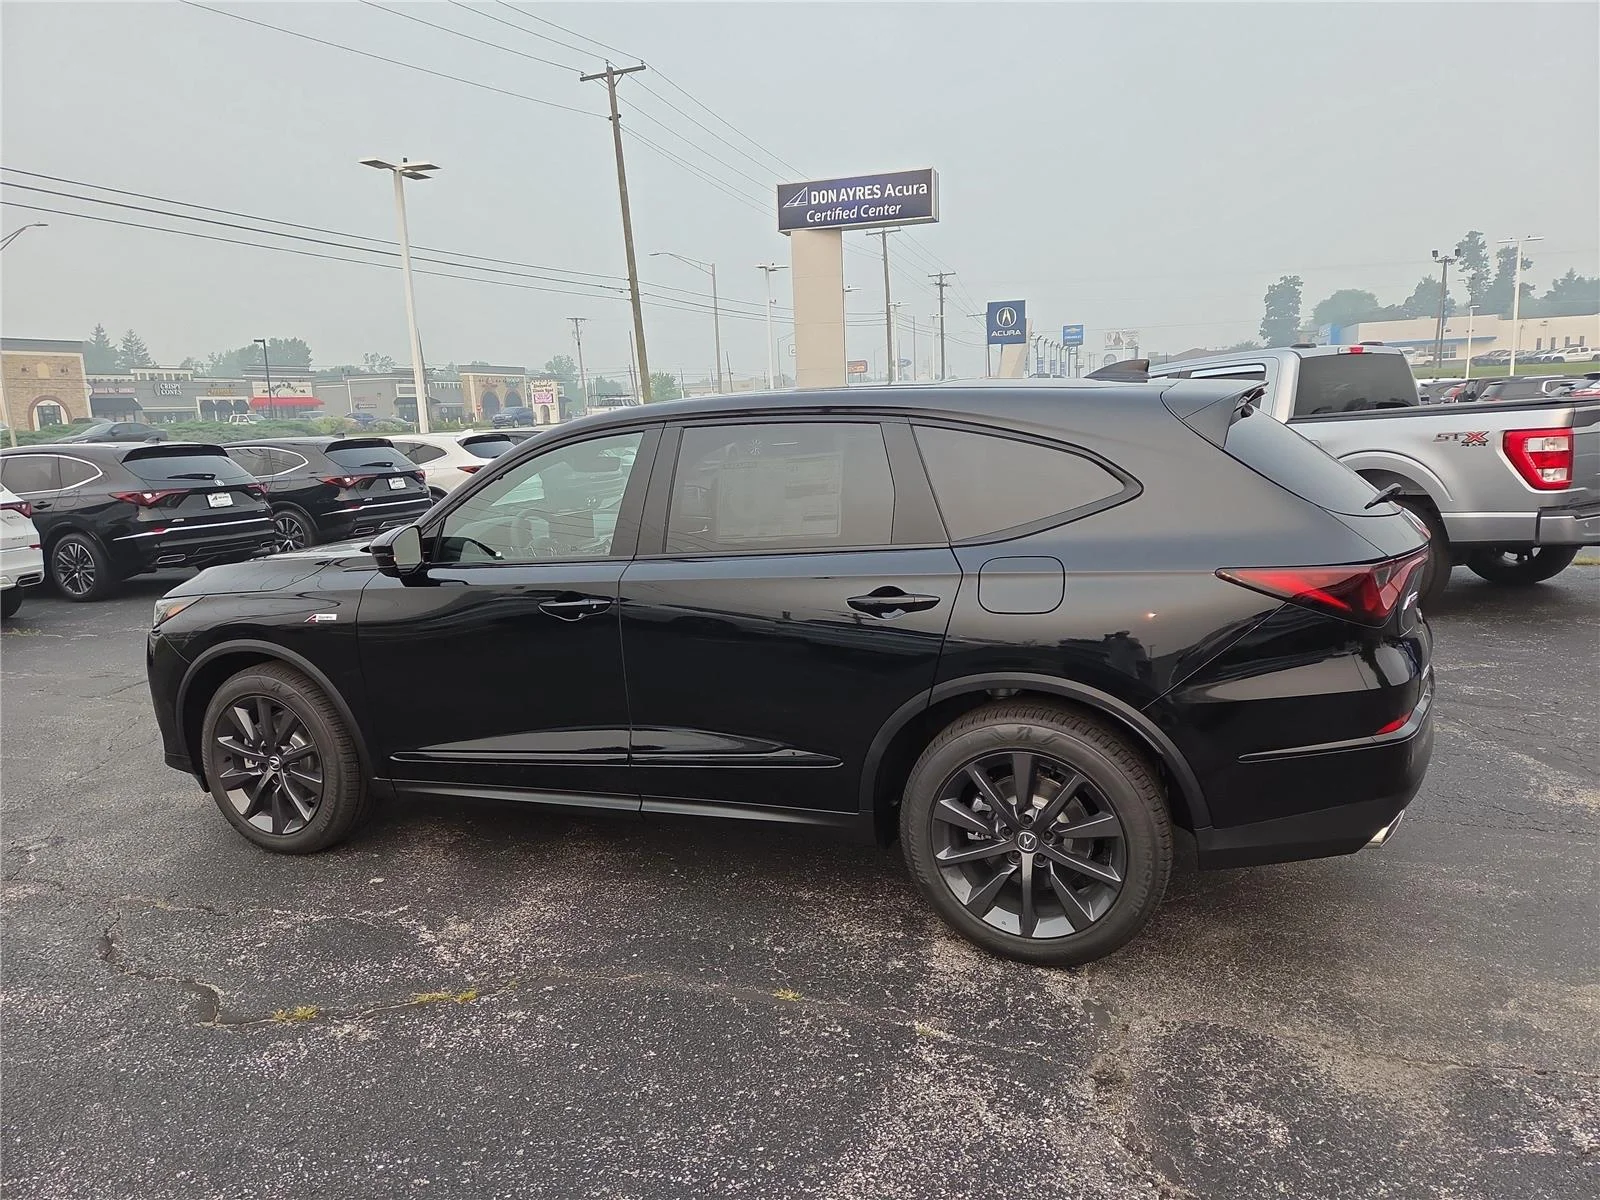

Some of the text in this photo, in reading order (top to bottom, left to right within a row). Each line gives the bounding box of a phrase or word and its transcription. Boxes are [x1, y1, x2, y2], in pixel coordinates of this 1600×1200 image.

[811, 184, 928, 205] DON AYRES Acura
[806, 203, 902, 223] Certified Center
[991, 329, 1022, 337] ACURA
[1433, 430, 1490, 444] STX
